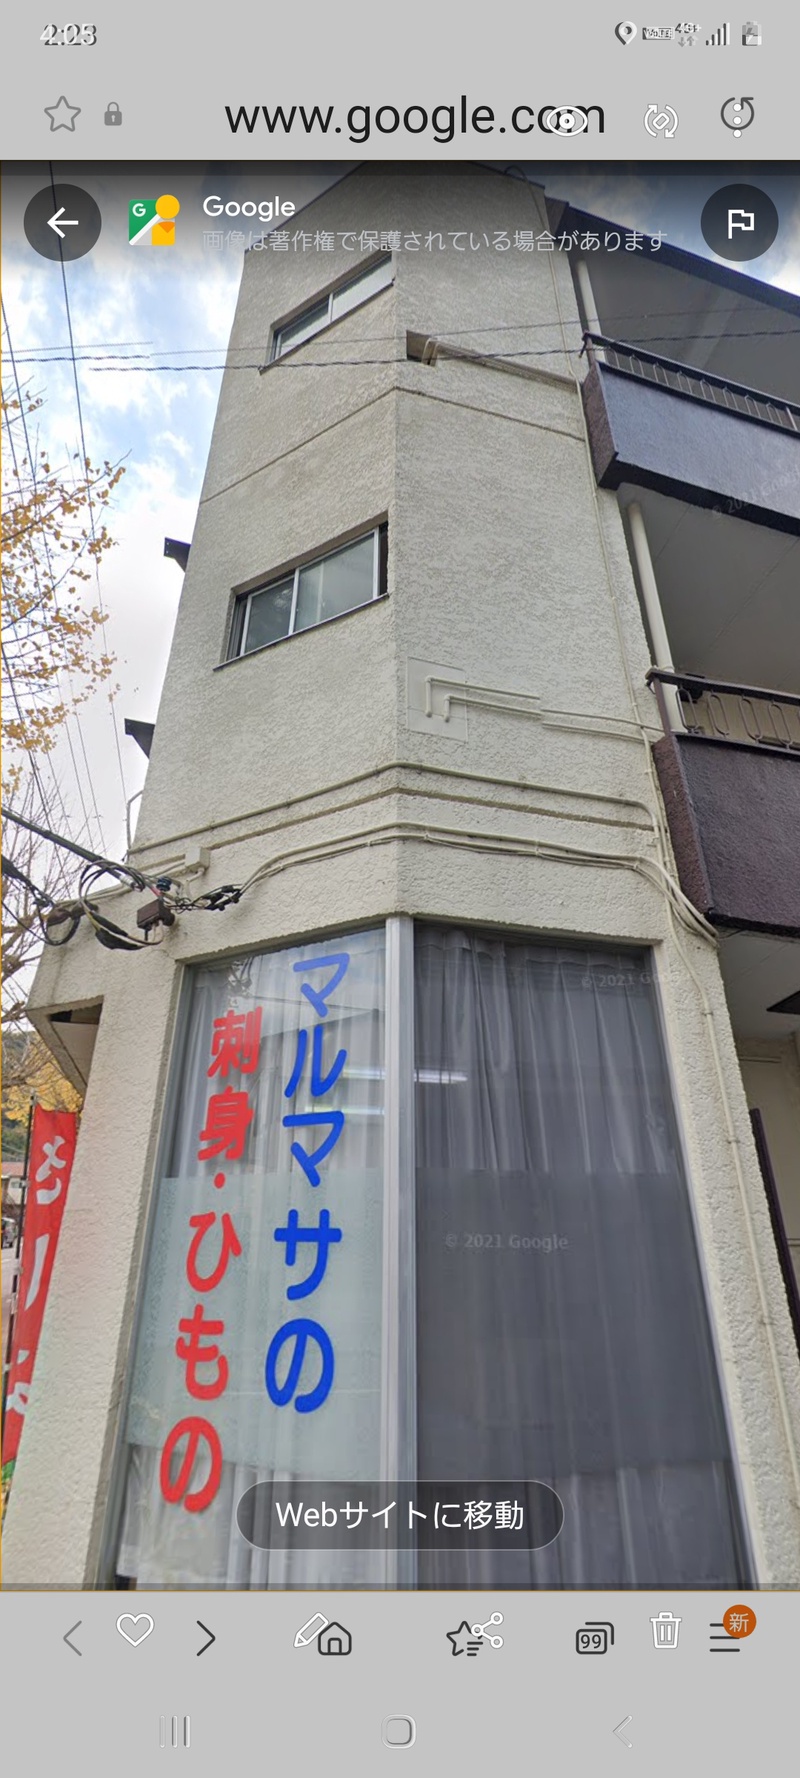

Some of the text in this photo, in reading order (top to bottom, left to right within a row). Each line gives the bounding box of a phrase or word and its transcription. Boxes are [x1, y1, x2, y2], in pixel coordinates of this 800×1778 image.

[225, 95, 605, 143] www.google.com
[202, 196, 296, 222] Google
[202, 230, 668, 252] 画像は著作権で保護されている場合があります
[264, 952, 350, 1415] マルマサの
[159, 1006, 263, 1514] 刺身・ひもの
[275, 1500, 525, 1530] Webサイトに移動
[729, 1612, 749, 1633] 新
[580, 1634, 602, 1649] 99
